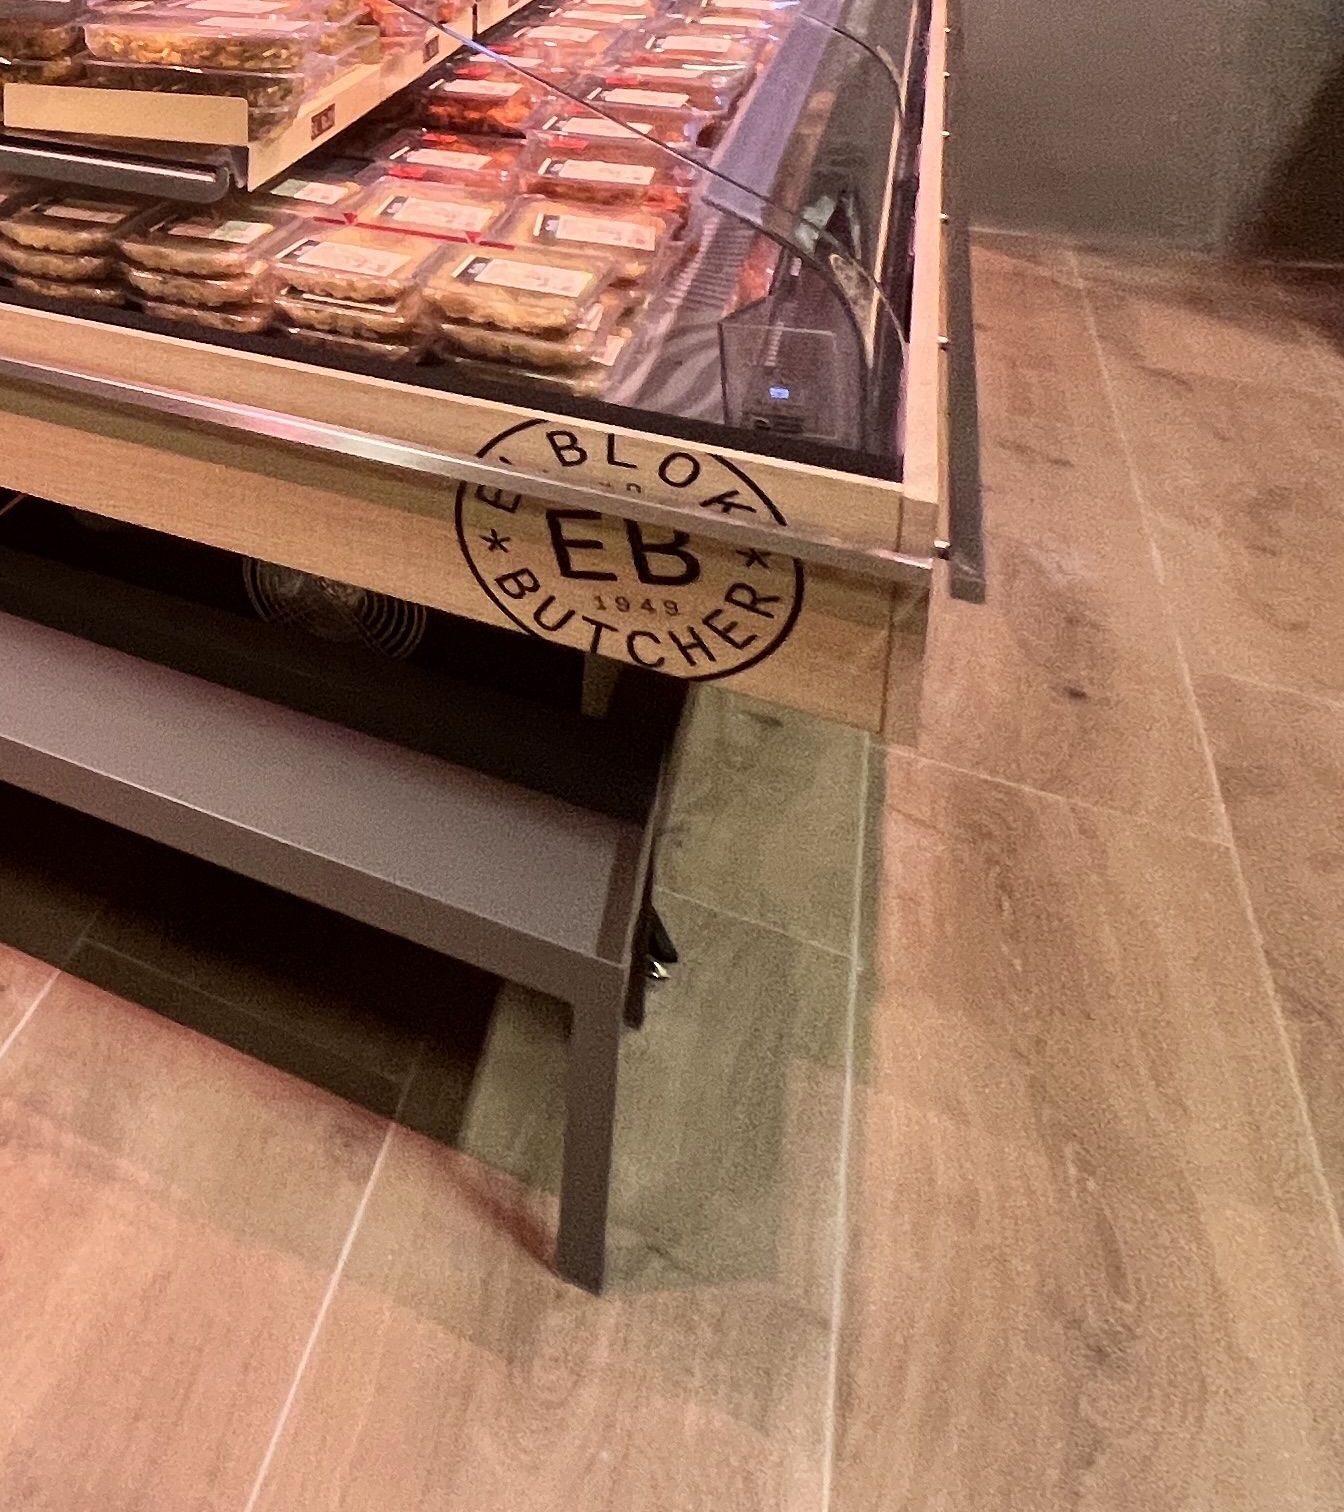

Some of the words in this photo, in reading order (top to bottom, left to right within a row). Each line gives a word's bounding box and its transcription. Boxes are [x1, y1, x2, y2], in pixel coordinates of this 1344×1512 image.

[546, 429, 757, 516] BLOK
[545, 508, 702, 587] EB
[494, 567, 781, 669] BUTCHER
[594, 595, 680, 617] 1949
